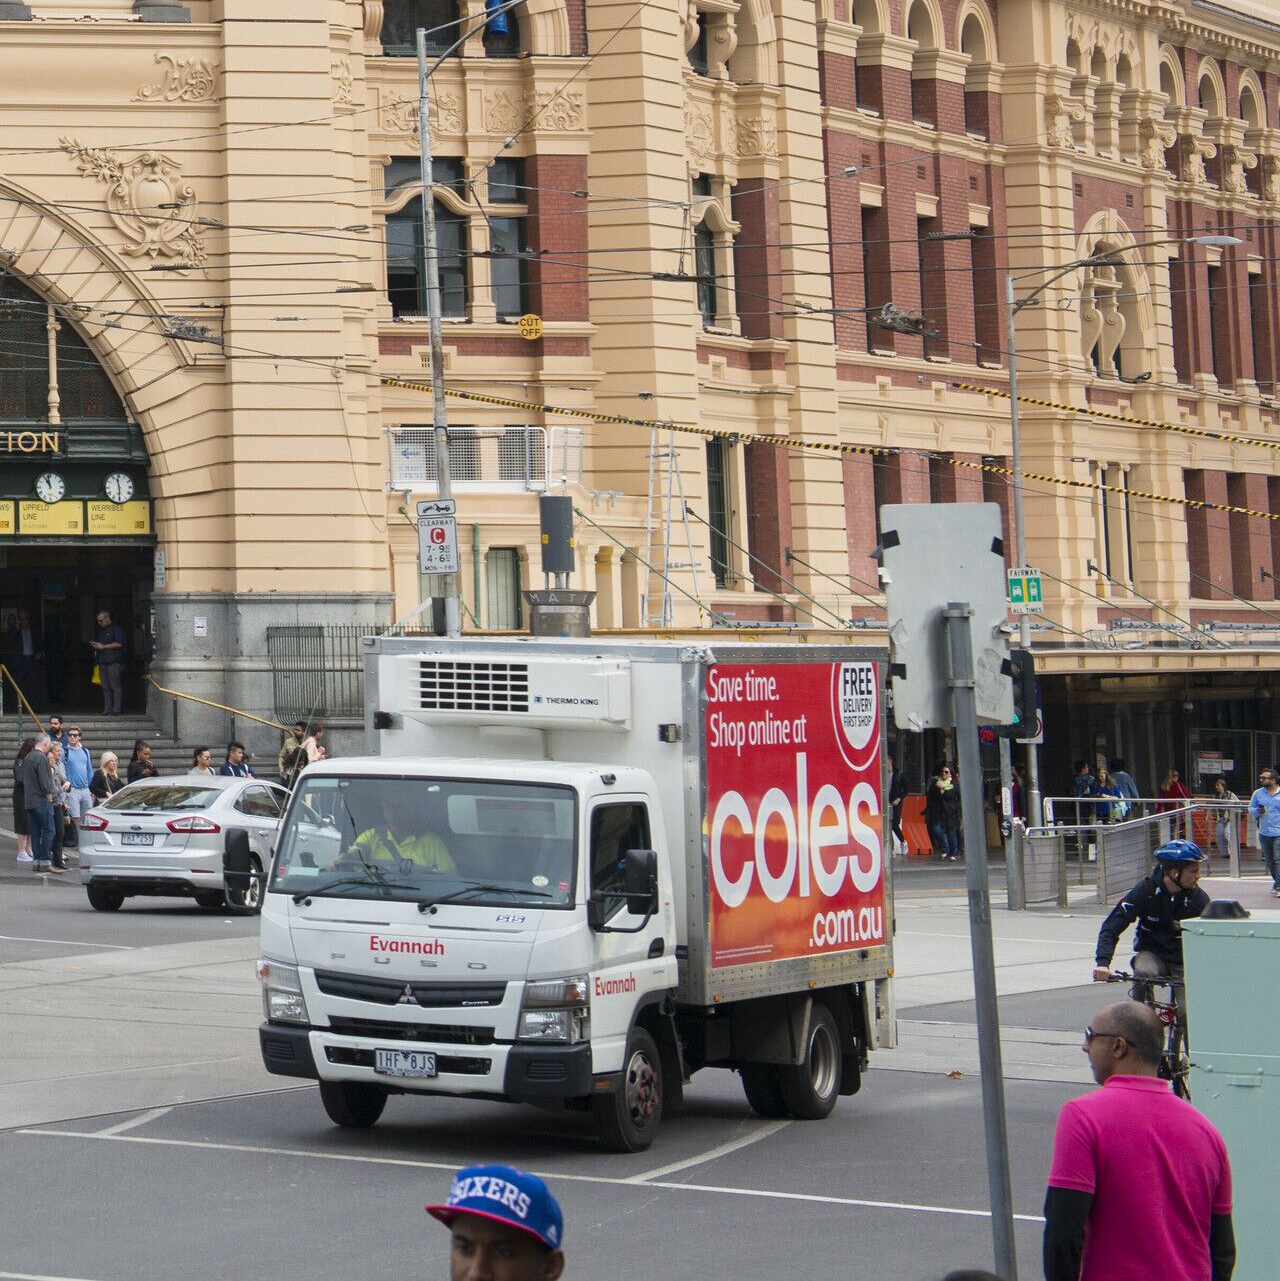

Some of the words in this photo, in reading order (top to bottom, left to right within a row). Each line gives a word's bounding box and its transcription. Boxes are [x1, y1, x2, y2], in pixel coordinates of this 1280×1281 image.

[520, 318, 540, 326] CUT
[521, 328, 540, 336] OFF
[420, 519, 454, 527] CLEARWAY
[709, 668, 743, 703] Save
[744, 669, 780, 702] time.
[843, 667, 873, 696] FREE
[546, 697, 579, 705] THERMO
[580, 698, 599, 706] KING
[843, 698, 873, 713] DELIVERY
[843, 715, 858, 727] FIRST
[710, 711, 746, 757] Shop
[748, 709, 790, 746] online
[793, 714, 808, 744] at
[711, 752, 882, 908] coles
[809, 906, 883, 947] .com.au
[370, 935, 445, 956] Evannah
[330, 953, 488, 970] FUSO
[594, 972, 636, 997] Evannah
[378, 1052, 400, 1068] 1HF
[410, 1054, 435, 1070] 8JS
[450, 1176, 531, 1219] SIXERS
